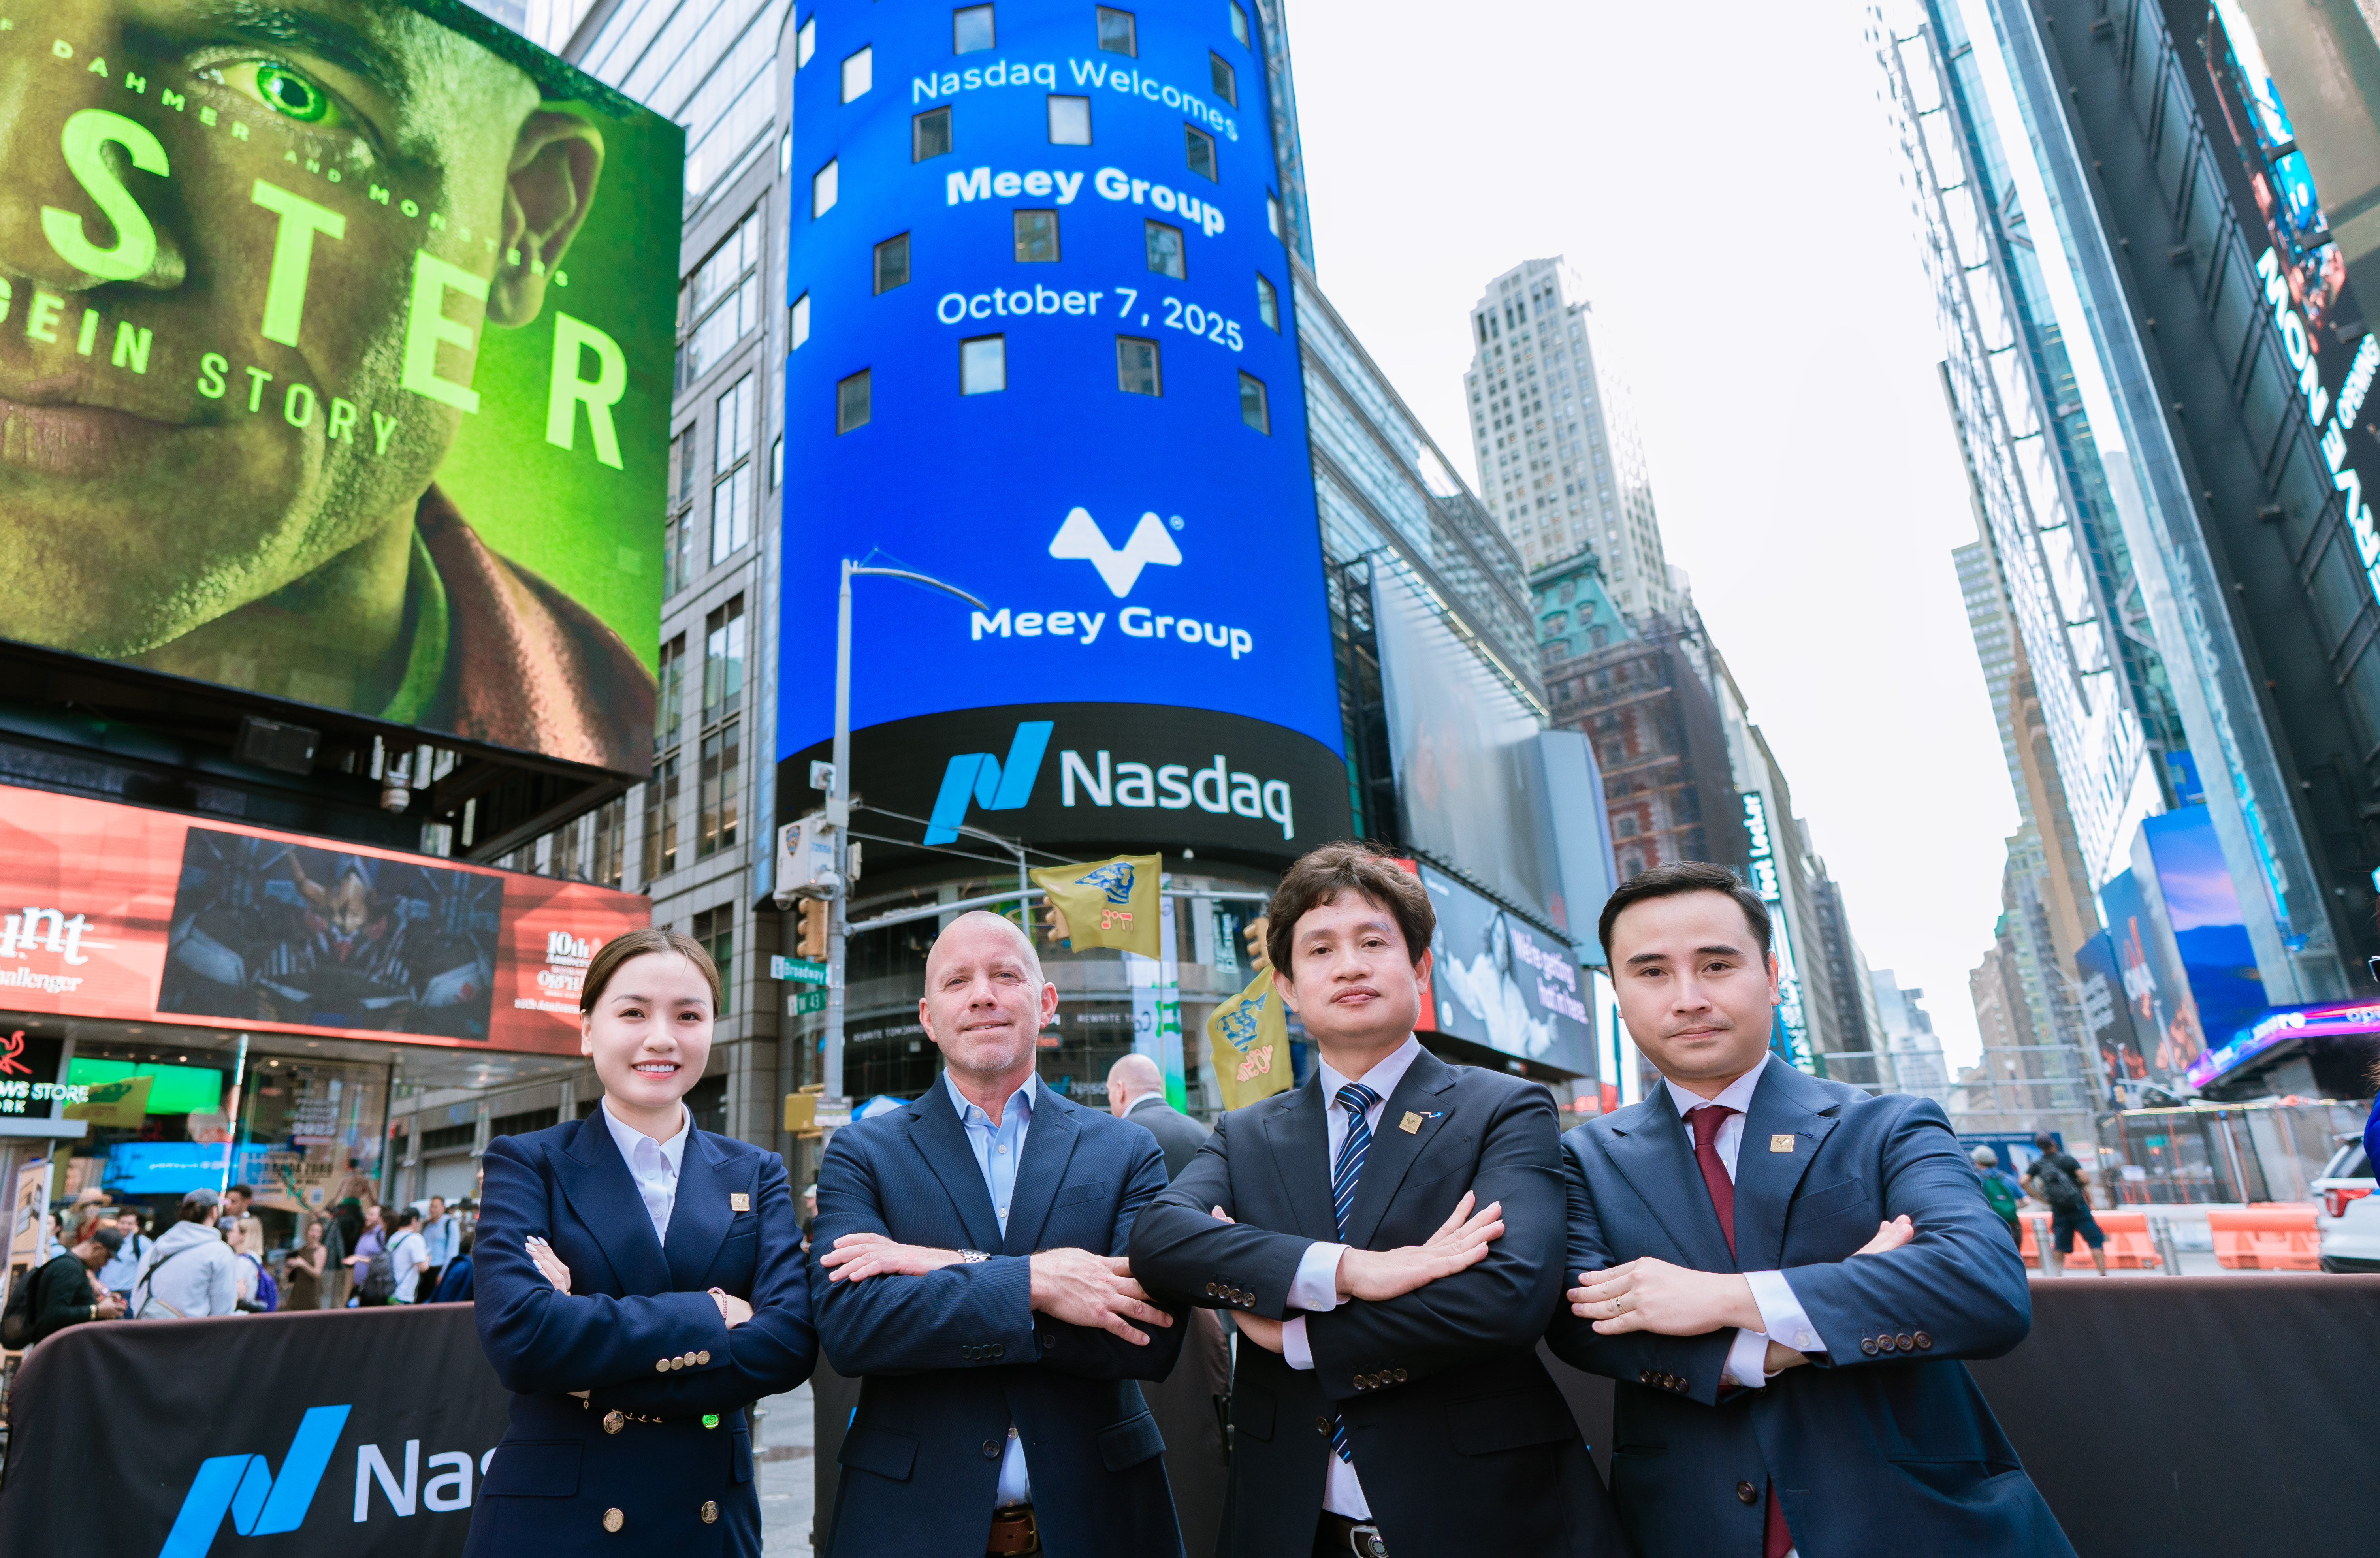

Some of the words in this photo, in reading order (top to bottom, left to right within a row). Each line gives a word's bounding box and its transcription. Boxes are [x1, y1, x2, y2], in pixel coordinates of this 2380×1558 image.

[913, 58, 1057, 104] Nasdaq
[1068, 58, 1238, 142] Welcomes
[52, 38, 250, 142] DAHMER
[283, 149, 342, 183] AND
[368, 183, 569, 288] MONSTERS
[947, 166, 1084, 205] Meey
[1094, 167, 1225, 237] Group
[41, 108, 628, 470] STER
[938, 284, 1103, 324] October
[1115, 287, 1149, 327] 7,
[1163, 297, 1243, 352] 2025
[2256, 246, 2329, 426] NOW
[197, 352, 398, 455] STORY
[971, 608, 1106, 645] Meey
[1119, 606, 1253, 660] Group
[1060, 751, 1294, 840] Nasdaq
[1742, 794, 1772, 858] Locker
[784, 962, 824, 984] Broadway
[885, 1024, 925, 1037] TOMORRO
[1077, 1013, 1122, 1024] REWRITE
[31, 1082, 90, 1105] STORE
[353, 1438, 497, 1524] Na
